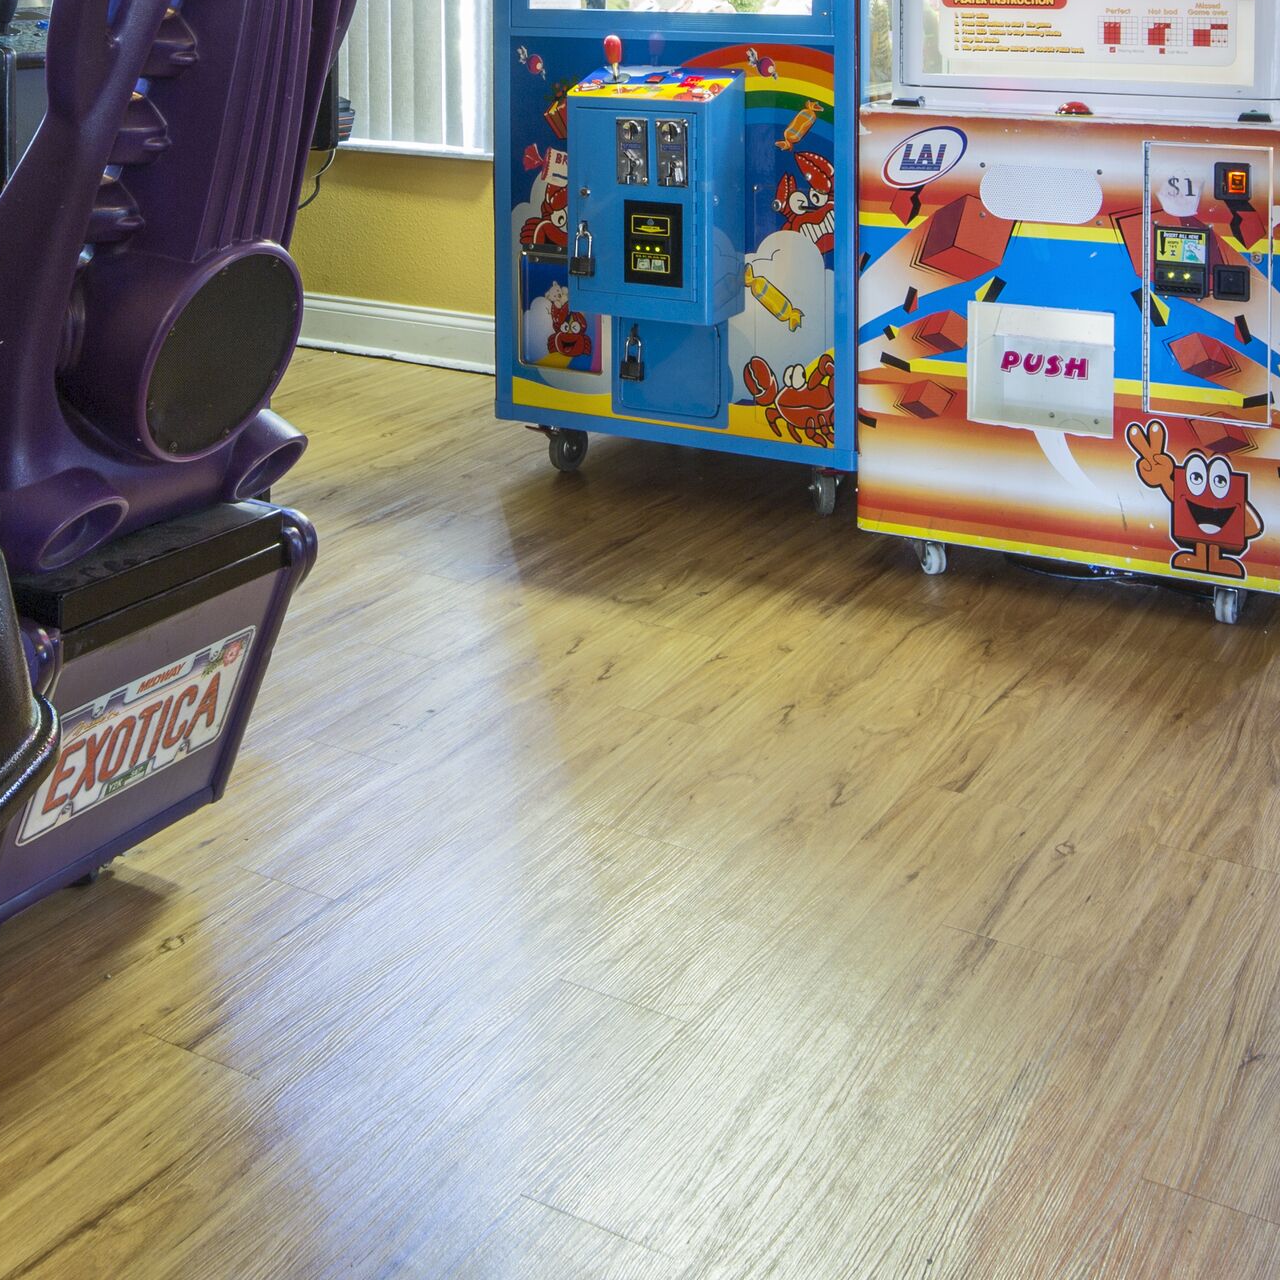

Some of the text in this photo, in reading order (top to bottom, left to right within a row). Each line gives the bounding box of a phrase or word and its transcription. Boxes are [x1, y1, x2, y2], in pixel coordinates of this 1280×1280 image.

[1105, 7, 1131, 16] Perfect
[555, 153, 567, 165] BR
[900, 143, 948, 170] LAI
[1167, 175, 1196, 197] $1
[1000, 350, 1089, 381] PUSH
[136, 661, 187, 695] MIDWAY
[41, 671, 222, 816] EXOTICA
